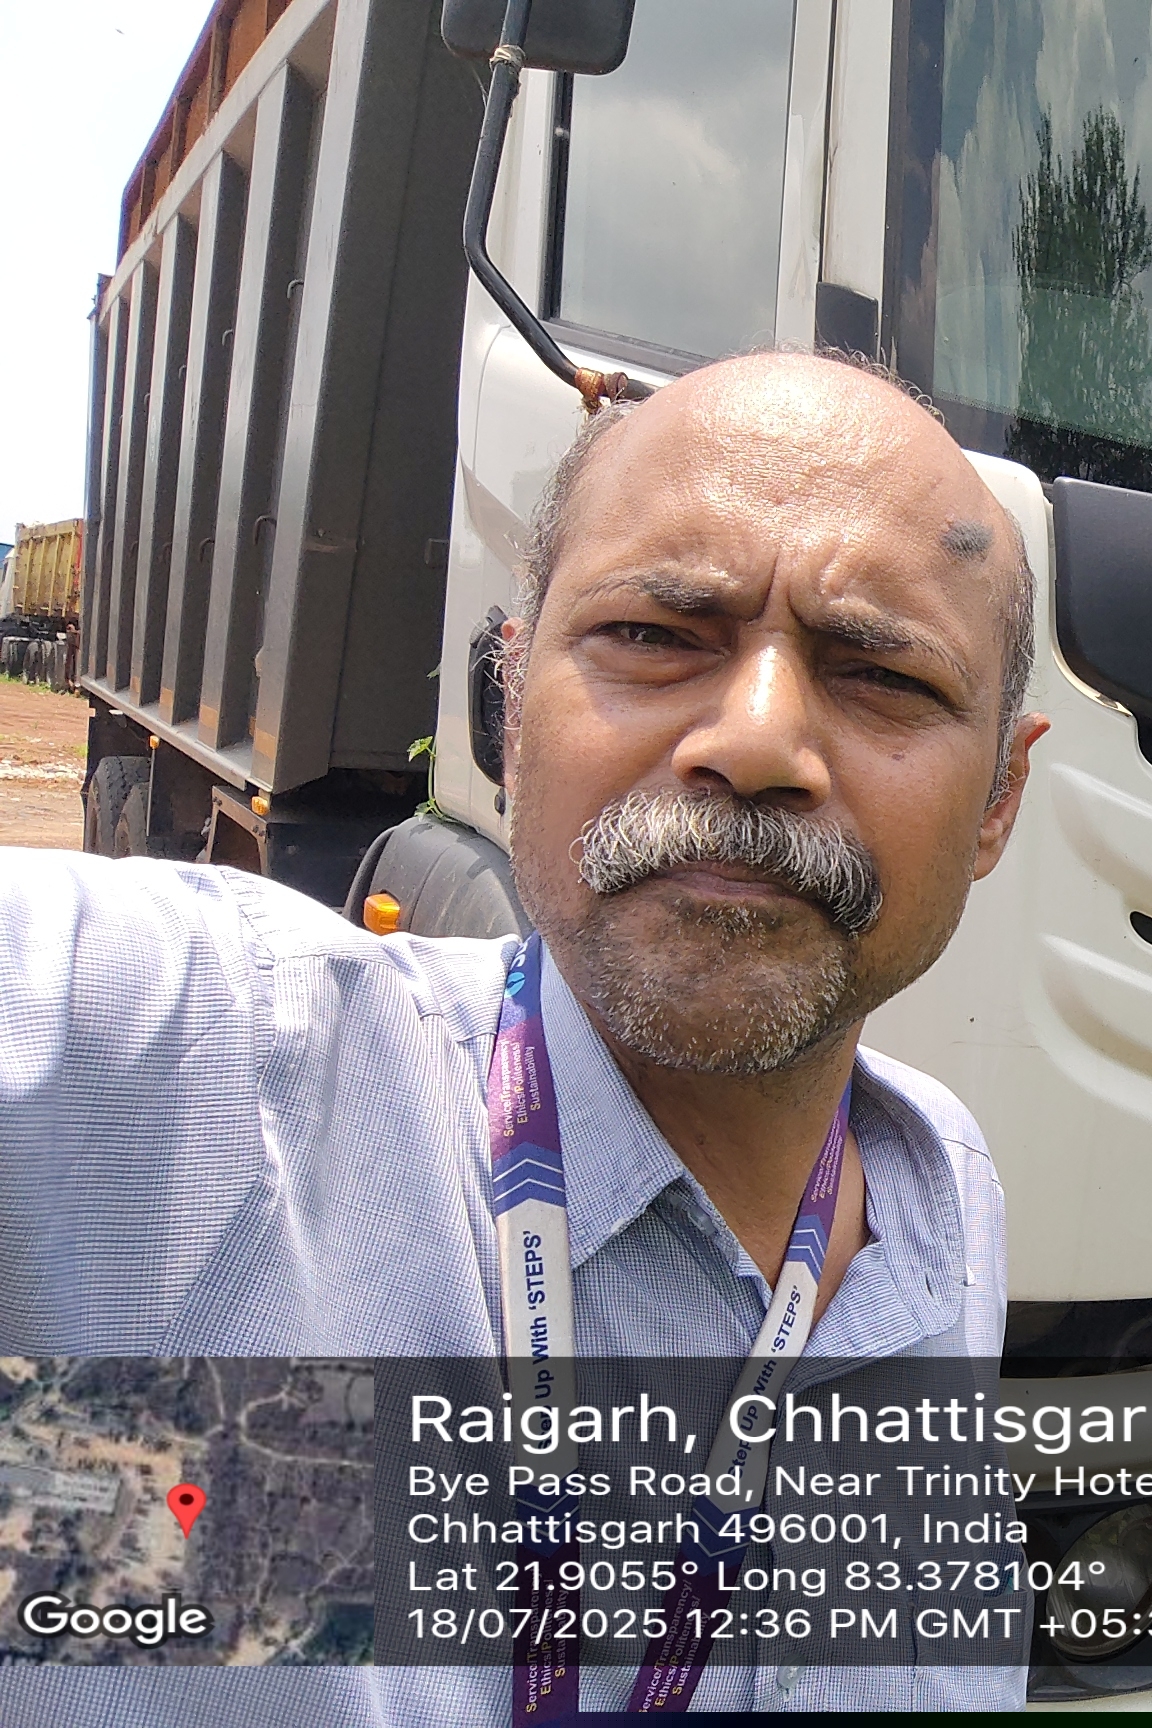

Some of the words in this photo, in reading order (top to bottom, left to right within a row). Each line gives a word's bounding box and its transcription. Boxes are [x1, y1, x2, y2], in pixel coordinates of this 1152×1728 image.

[525, 1045, 542, 1112] Sustainability
[529, 1315, 550, 1364] With
[532, 1368, 555, 1400] Up
[740, 1405, 759, 1432] Up
